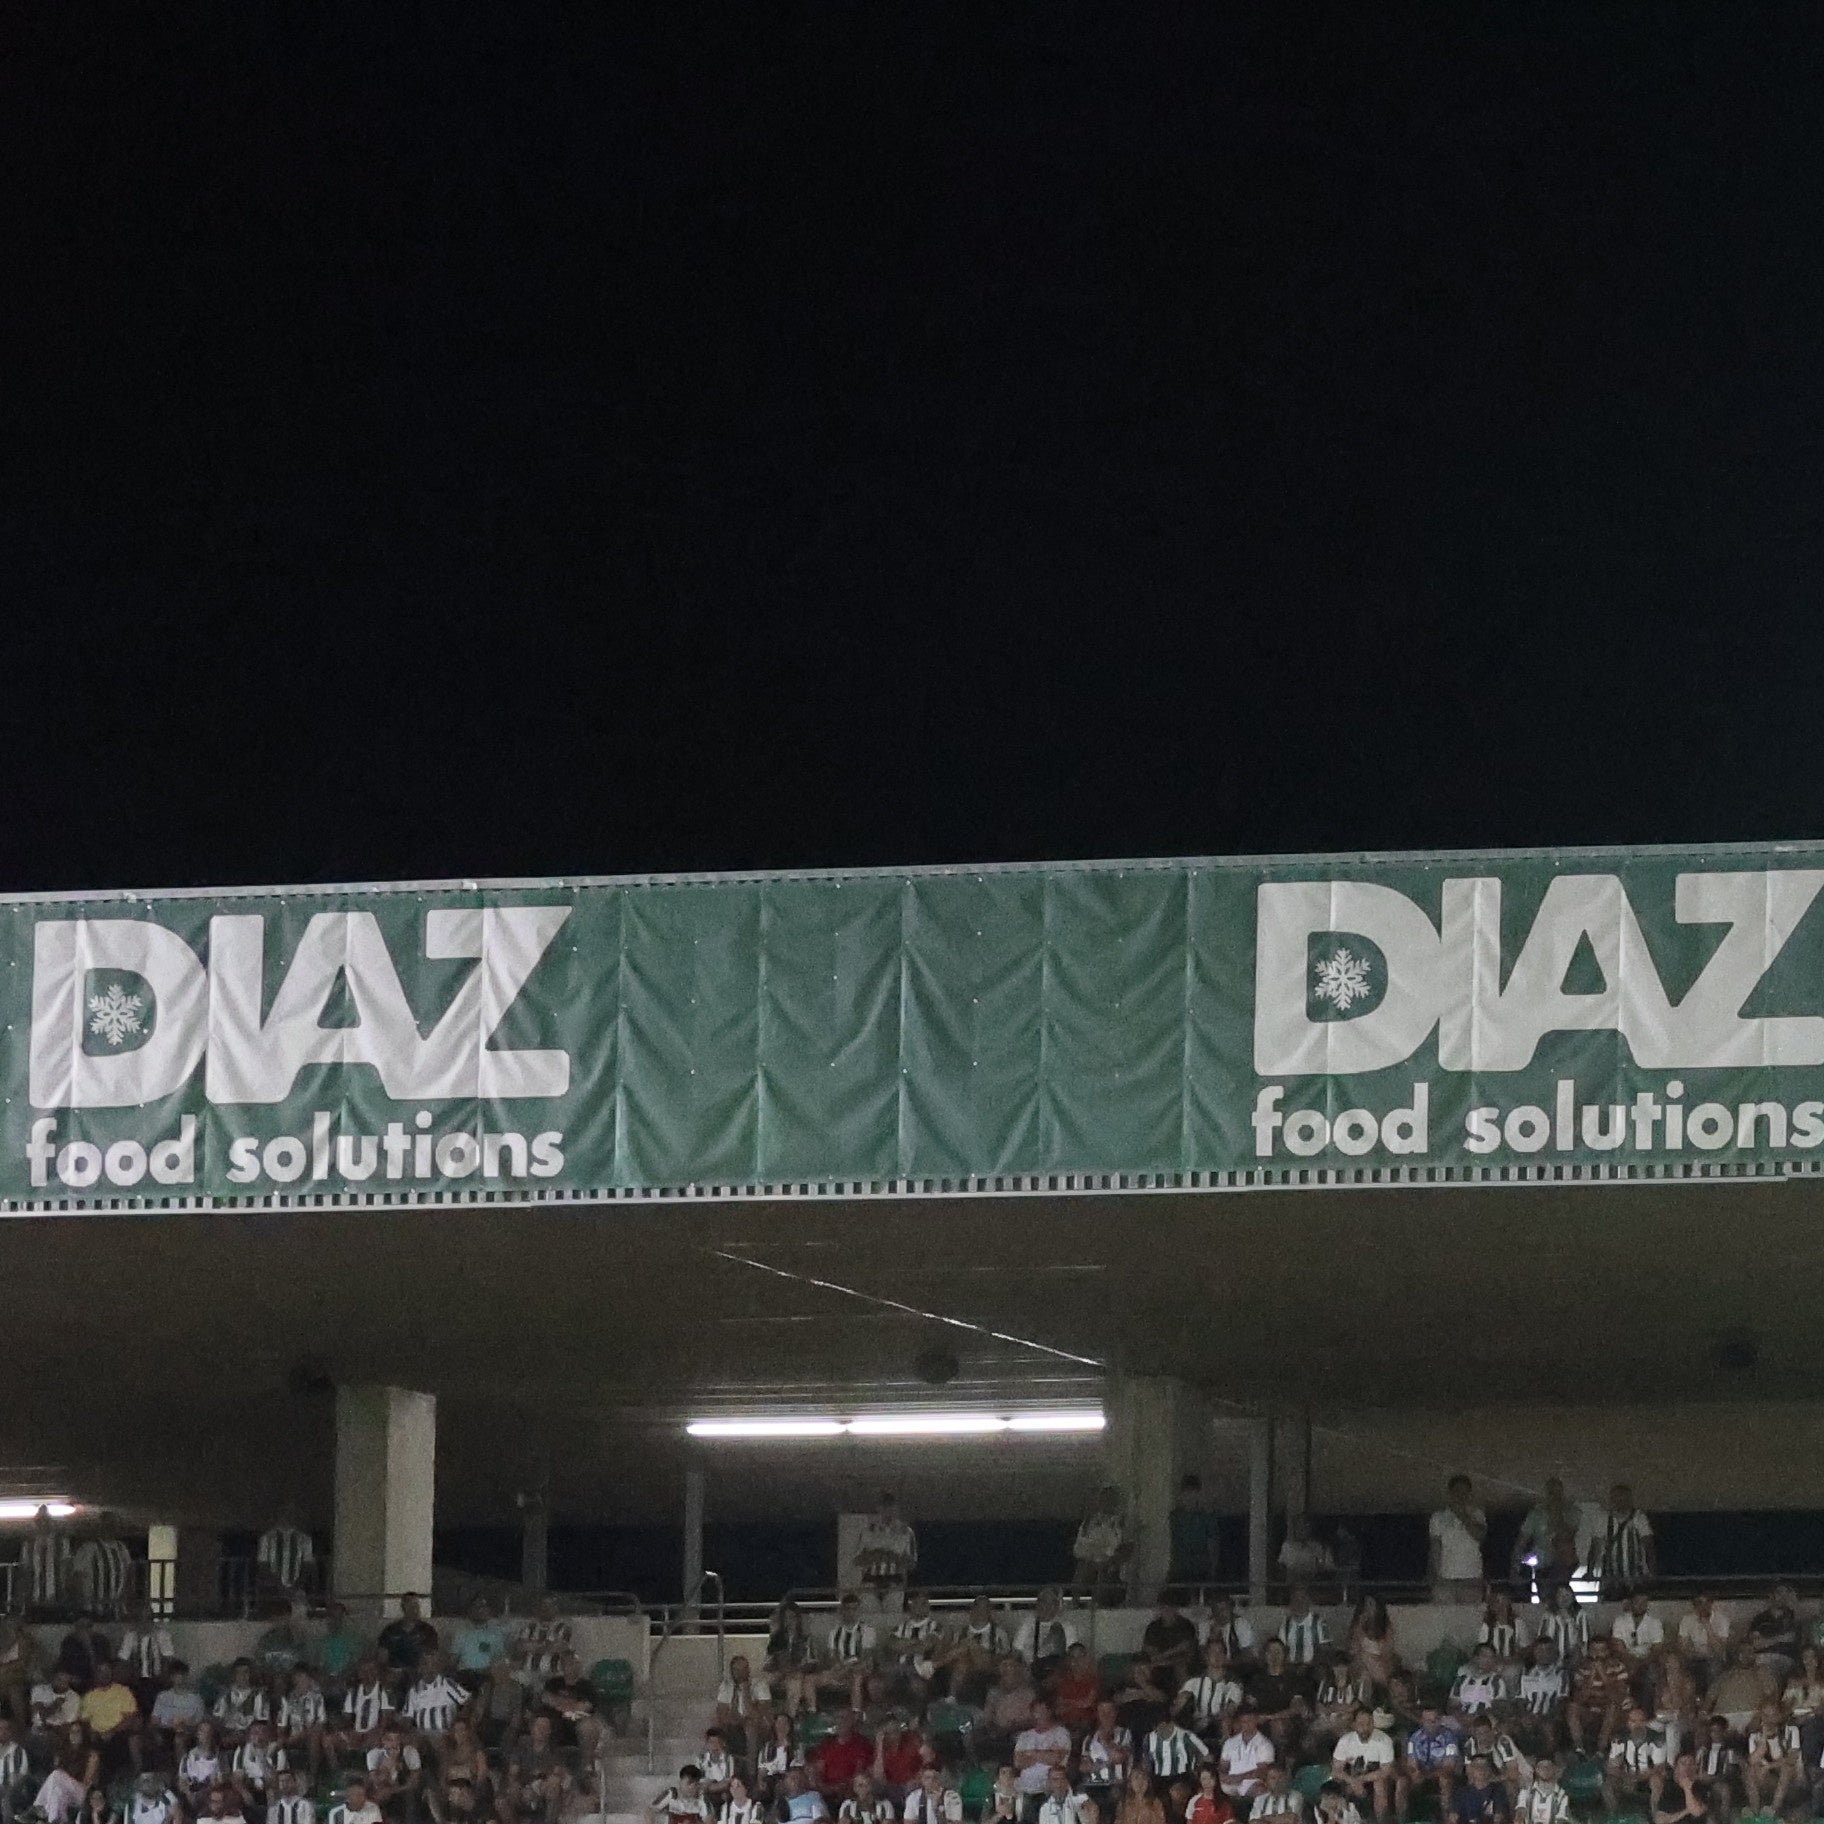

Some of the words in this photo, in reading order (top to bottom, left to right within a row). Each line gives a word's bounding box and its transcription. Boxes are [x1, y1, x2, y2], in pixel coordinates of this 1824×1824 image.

[28, 905, 573, 1108] DIAZ
[26, 1114, 195, 1188] food
[227, 1111, 565, 1184] solutions
[1252, 1082, 1429, 1157] food
